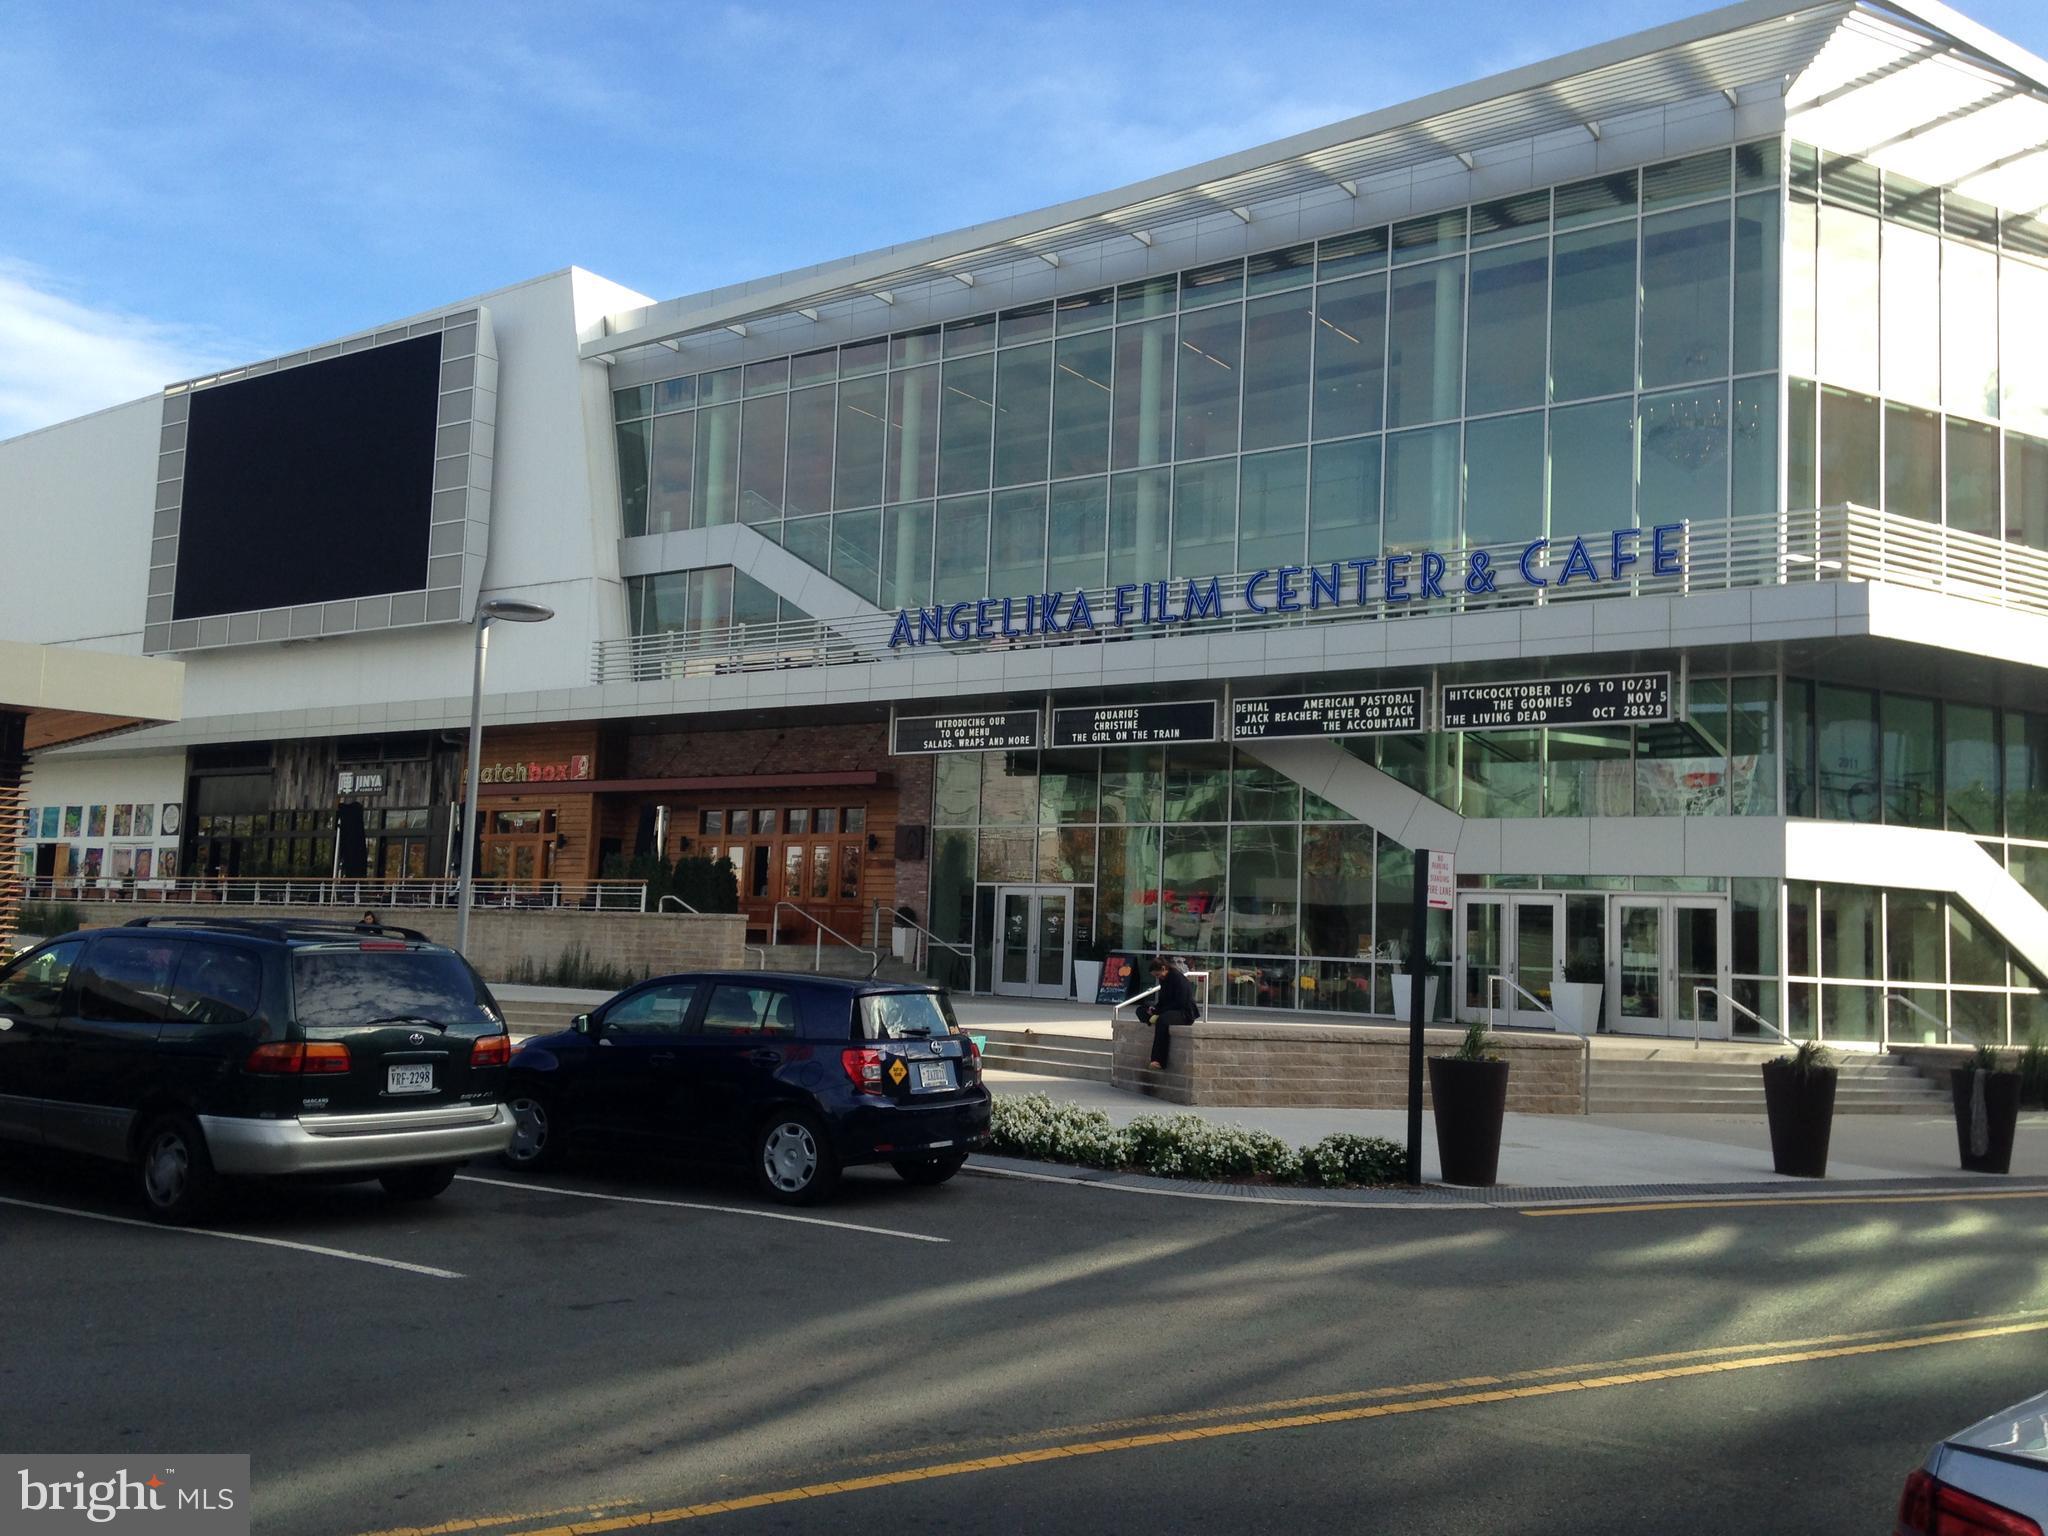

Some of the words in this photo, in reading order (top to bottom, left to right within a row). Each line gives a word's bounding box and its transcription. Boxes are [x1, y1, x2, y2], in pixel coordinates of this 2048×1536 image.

[888, 590, 1094, 648] ANGELIKA
[1114, 576, 1222, 627] FILM
[1244, 552, 1446, 614] CENTER
[1464, 550, 1496, 594] &
[1518, 523, 1684, 587] CAFE
[1450, 685, 1550, 700] HITCHCOCKTOBER
[1562, 682, 1590, 694] 10/6
[1598, 682, 1614, 692] TO
[1622, 679, 1656, 690] 10/31
[1304, 697, 1354, 709] AMERICAN
[1360, 694, 1414, 706] PASTORAL
[1494, 700, 1514, 710] THE
[1520, 696, 1572, 709] GOONIES
[1628, 692, 1651, 704] NOV
[1660, 691, 1666, 702] 5
[1236, 702, 1269, 712] DENIAL
[1592, 707, 1616, 718] OCT
[1624, 704, 1662, 716] 28&29
[1094, 710, 1138, 720] AQUARIUS
[1245, 714, 1268, 724] JACK
[1275, 711, 1322, 722] REACHER:
[1328, 708, 1360, 719] NEVER
[1366, 708, 1379, 717] GO
[1386, 706, 1412, 716] BACK
[1446, 714, 1466, 724] THE
[1472, 712, 1510, 724] LIVING
[1517, 710, 1546, 722] DEAD
[936, 718, 985, 728] INTRODUCING
[990, 716, 1006, 726] OUR
[1094, 720, 1138, 730] CHRISTINE
[1322, 721, 1340, 730] THE
[1346, 718, 1414, 730] ACCOUNTANT
[941, 730, 950, 738] TO
[954, 729, 964, 737] GO
[968, 728, 990, 736] MENU
[1072, 733, 1087, 742] THE
[1092, 732, 1110, 741] GIRL
[1116, 731, 1127, 740] ON
[1132, 730, 1148, 739] THE
[1154, 728, 1180, 738] TRAIN
[1236, 725, 1264, 735] SULLY
[958, 738, 984, 746] WRAPS
[988, 737, 1004, 746] AND
[1008, 736, 1030, 744] MORE
[354, 774, 382, 792] JINYA
[1440, 886, 1452, 896] LANE
